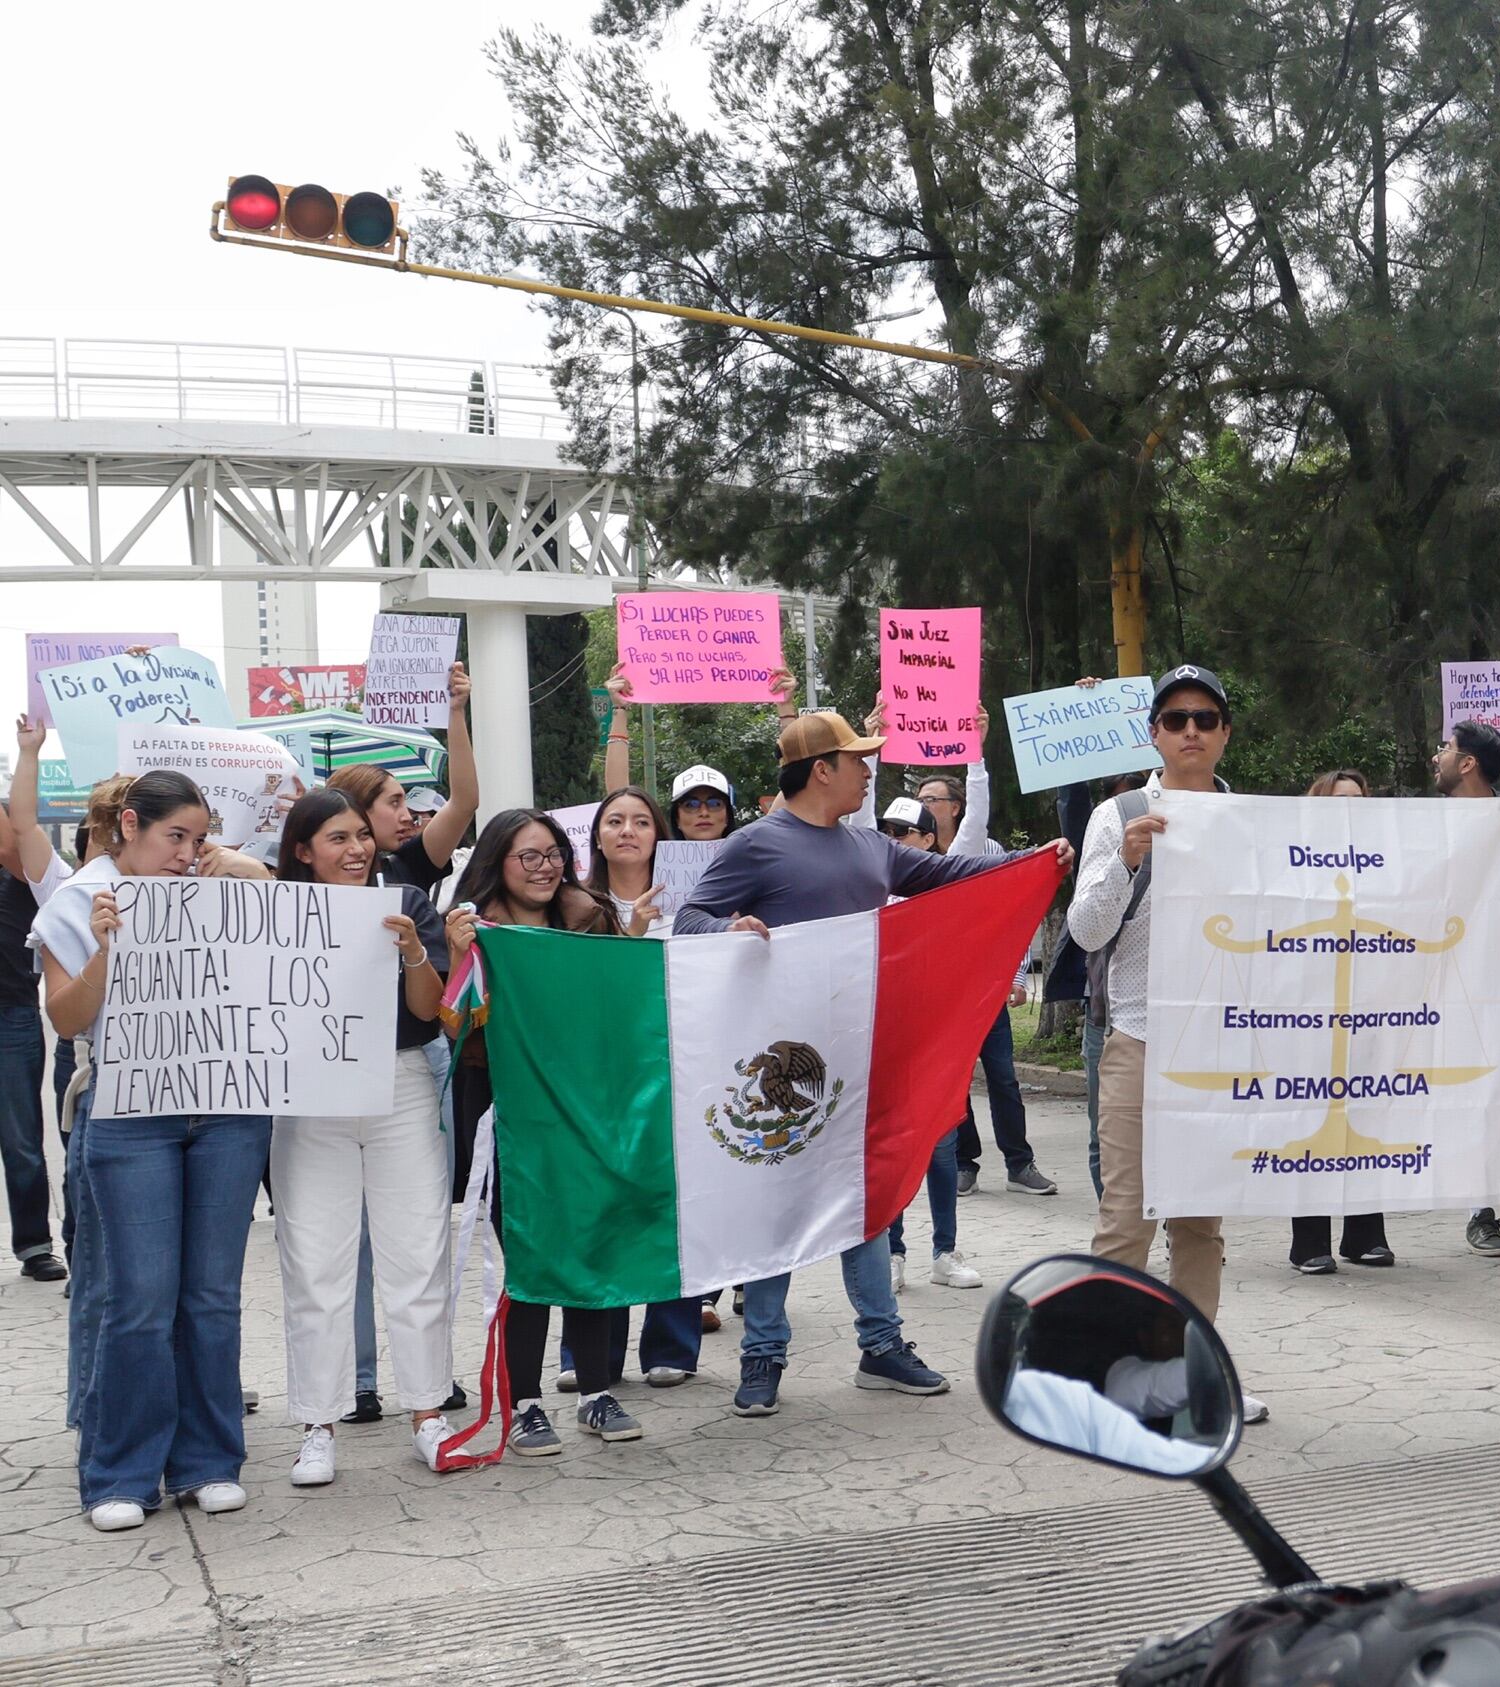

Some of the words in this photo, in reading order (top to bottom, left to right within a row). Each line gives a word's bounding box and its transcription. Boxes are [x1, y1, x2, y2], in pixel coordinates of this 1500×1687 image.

[622, 600, 643, 621] SI
[651, 606, 708, 624] LUCHAS
[714, 607, 764, 622] PUEDES
[636, 625, 692, 642] PERDER
[697, 630, 708, 643] O
[713, 630, 760, 644] GANAR
[625, 647, 656, 663] PERO
[661, 652, 673, 661] SI
[677, 652, 694, 662] NO
[699, 652, 747, 663] LUCHAS,
[92, 677, 108, 692] a
[113, 662, 141, 687] la
[204, 671, 216, 689] de
[297, 671, 349, 698] VIVE
[650, 668, 670, 685] YA
[675, 669, 703, 683] HAS
[711, 667, 767, 682] PERDIDO
[1450, 669, 1468, 689] Hoy
[1470, 673, 1487, 683] nos
[108, 684, 189, 717] Poderes!
[366, 690, 447, 706] INDEPENDENCIA
[893, 685, 908, 700] NO
[1450, 700, 1469, 719] para
[1470, 699, 1500, 713] seguir
[958, 718, 973, 731] DE
[133, 740, 149, 750] LA
[152, 740, 189, 750] FALTA
[191, 740, 207, 751] DE
[41, 765, 72, 778] UN
[136, 755, 192, 767] TAMBIÉN
[195, 758, 208, 767] ES
[211, 756, 283, 769] CORRUPCIÓN
[682, 770, 719, 787] PJF
[213, 786, 228, 797] SE
[231, 788, 258, 809] TOCA
[1289, 844, 1385, 874] Disculpe
[111, 881, 199, 944] PODER
[202, 881, 341, 950] JUDICIAL
[1266, 928, 1307, 954] Las
[1312, 928, 1416, 954] molestias
[108, 948, 231, 1006] AGUANTA!
[269, 955, 330, 1008] LOS
[1223, 1005, 1323, 1030] Estamos
[1328, 1002, 1441, 1035] reparando
[104, 1004, 289, 1065] ESTUDIANTES
[322, 1014, 364, 1062] SE
[1232, 1078, 1263, 1101] LA
[1275, 1072, 1430, 1101] DEMOCRACIA
[1251, 1144, 1433, 1176] #todossomospjf
